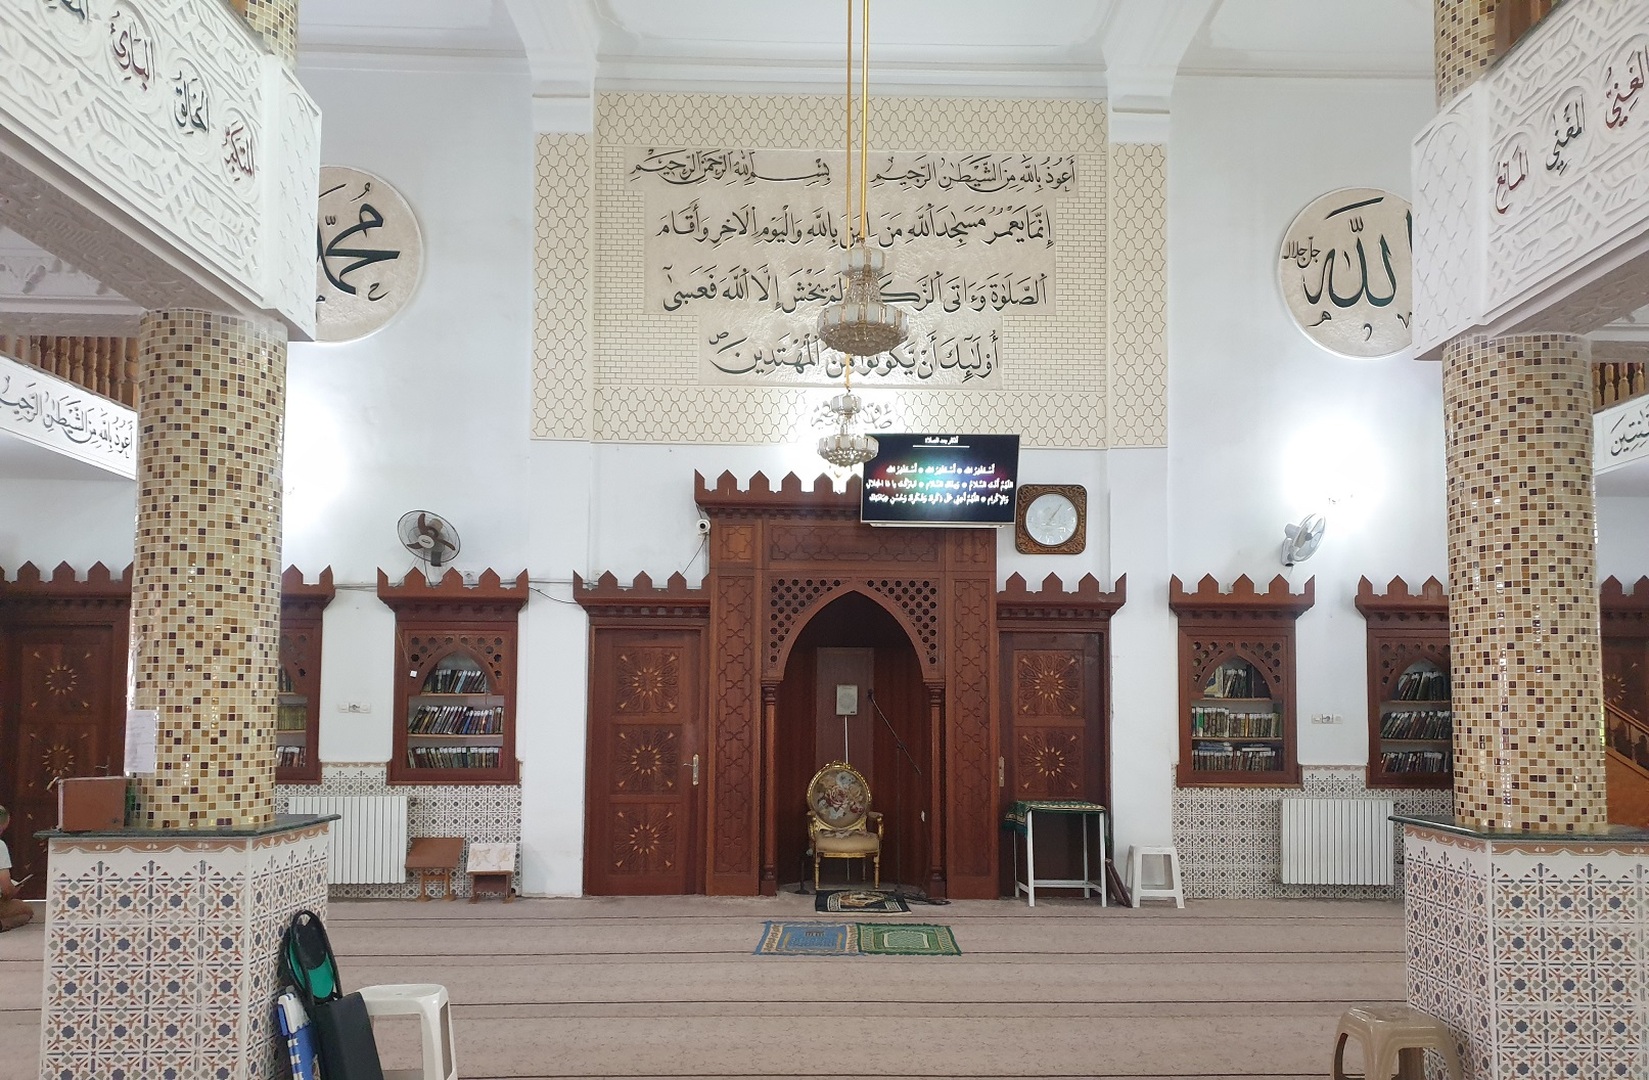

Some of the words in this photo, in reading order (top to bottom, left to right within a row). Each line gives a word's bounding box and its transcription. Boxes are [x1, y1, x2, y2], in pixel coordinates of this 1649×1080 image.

[172, 69, 210, 136] الخالق
[1546, 94, 1586, 176] المغني
[629, 148, 701, 182] الرحيم
[725, 150, 755, 186] الله
[743, 157, 832, 187] بسم
[869, 154, 937, 189] الرجيم
[1015, 154, 1047, 193] بالله
[1044, 154, 1076, 192] أعوذ
[656, 198, 712, 243] وأقام
[755, 205, 802, 246] واليوم
[806, 206, 839, 250] بالله
[878, 211, 903, 248] من
[904, 203, 936, 244] الله
[981, 205, 1026, 245] يعمر
[1025, 204, 1054, 249] إنما
[662, 265, 718, 312] فعسى
[719, 265, 751, 301] الله
[751, 264, 783, 312] إلا
[879, 271, 943, 312] الزك
[708, 333, 820, 378] المهتدين
[917, 331, 940, 380] أن
[0, 383, 42, 422] الرجي
[62, 408, 97, 444] من
[97, 408, 114, 452] بالله
[112, 416, 133, 458] أعوذ
